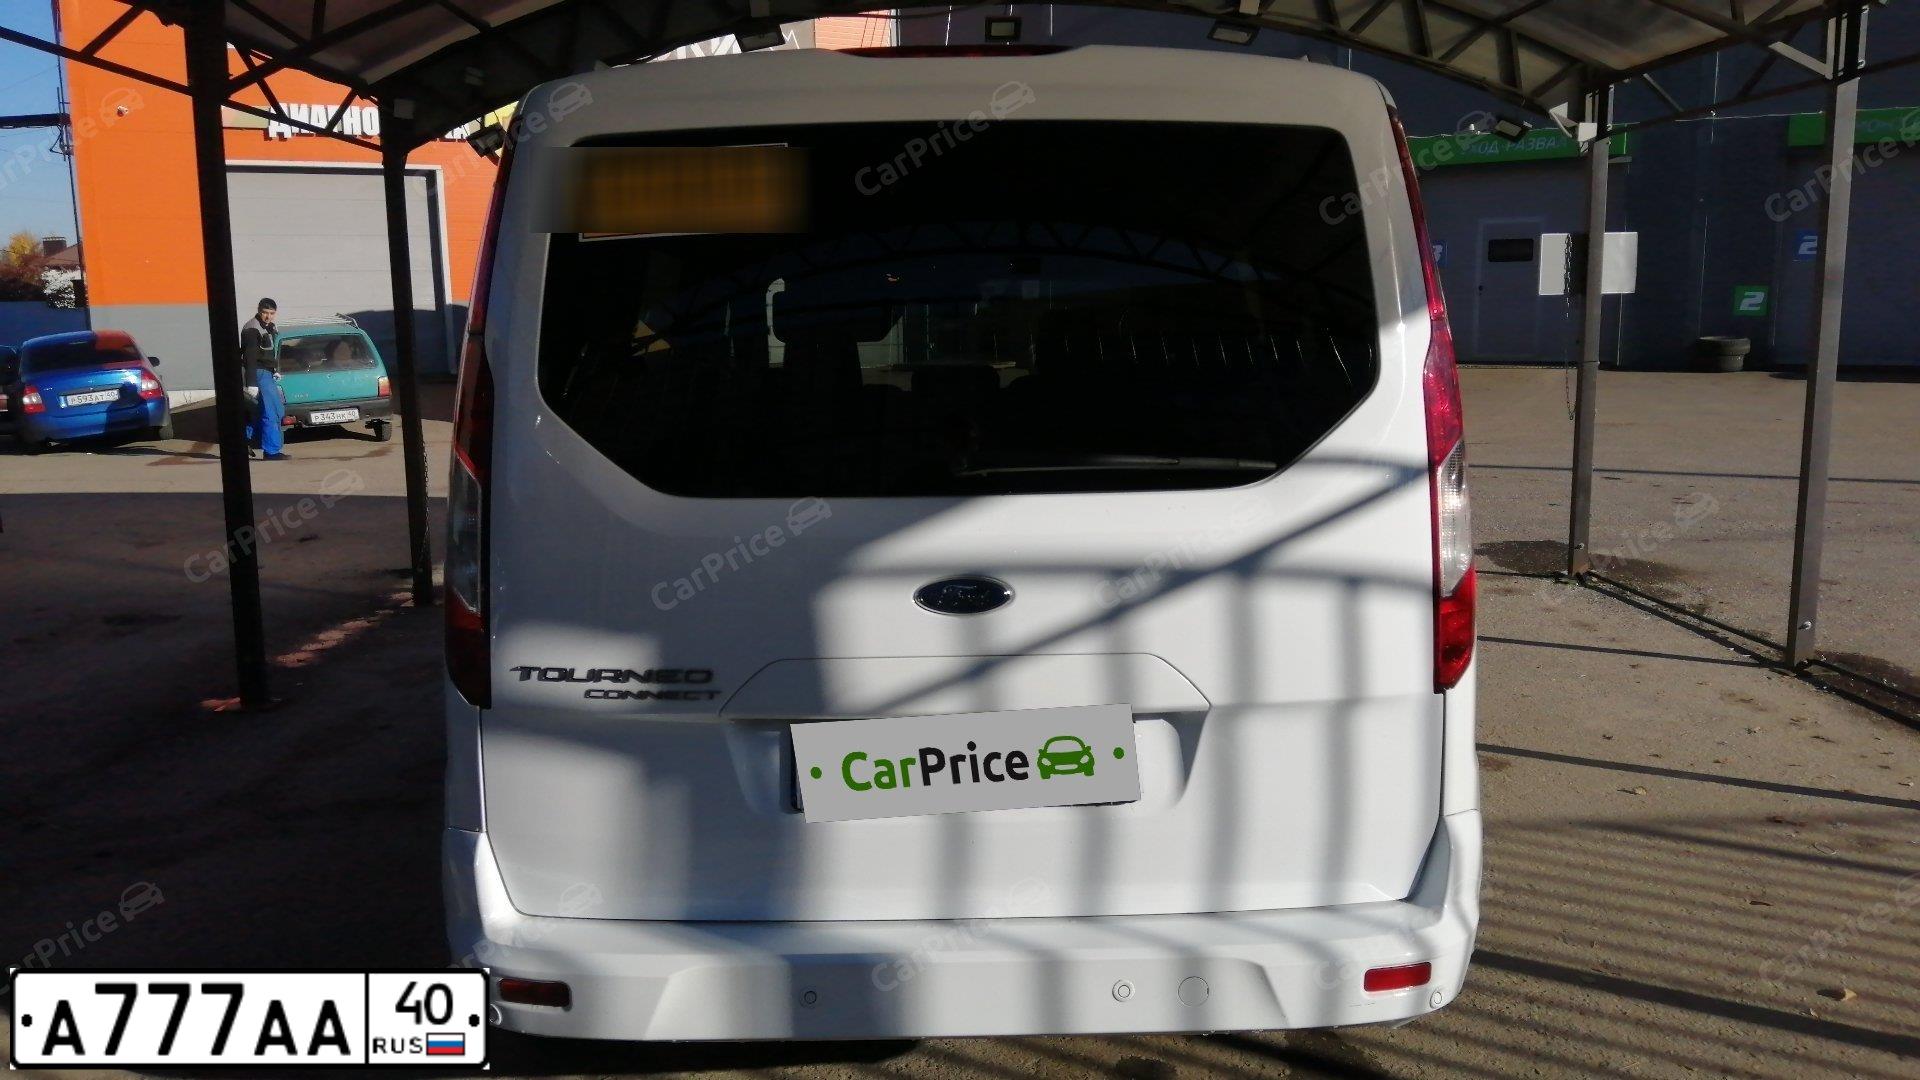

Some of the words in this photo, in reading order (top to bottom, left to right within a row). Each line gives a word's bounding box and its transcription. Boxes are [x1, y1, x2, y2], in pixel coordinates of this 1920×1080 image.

[1799, 235, 1818, 255] 2
[1739, 292, 1765, 310] 2
[510, 667, 714, 684] TOURNEO
[584, 689, 722, 700] CONNECT
